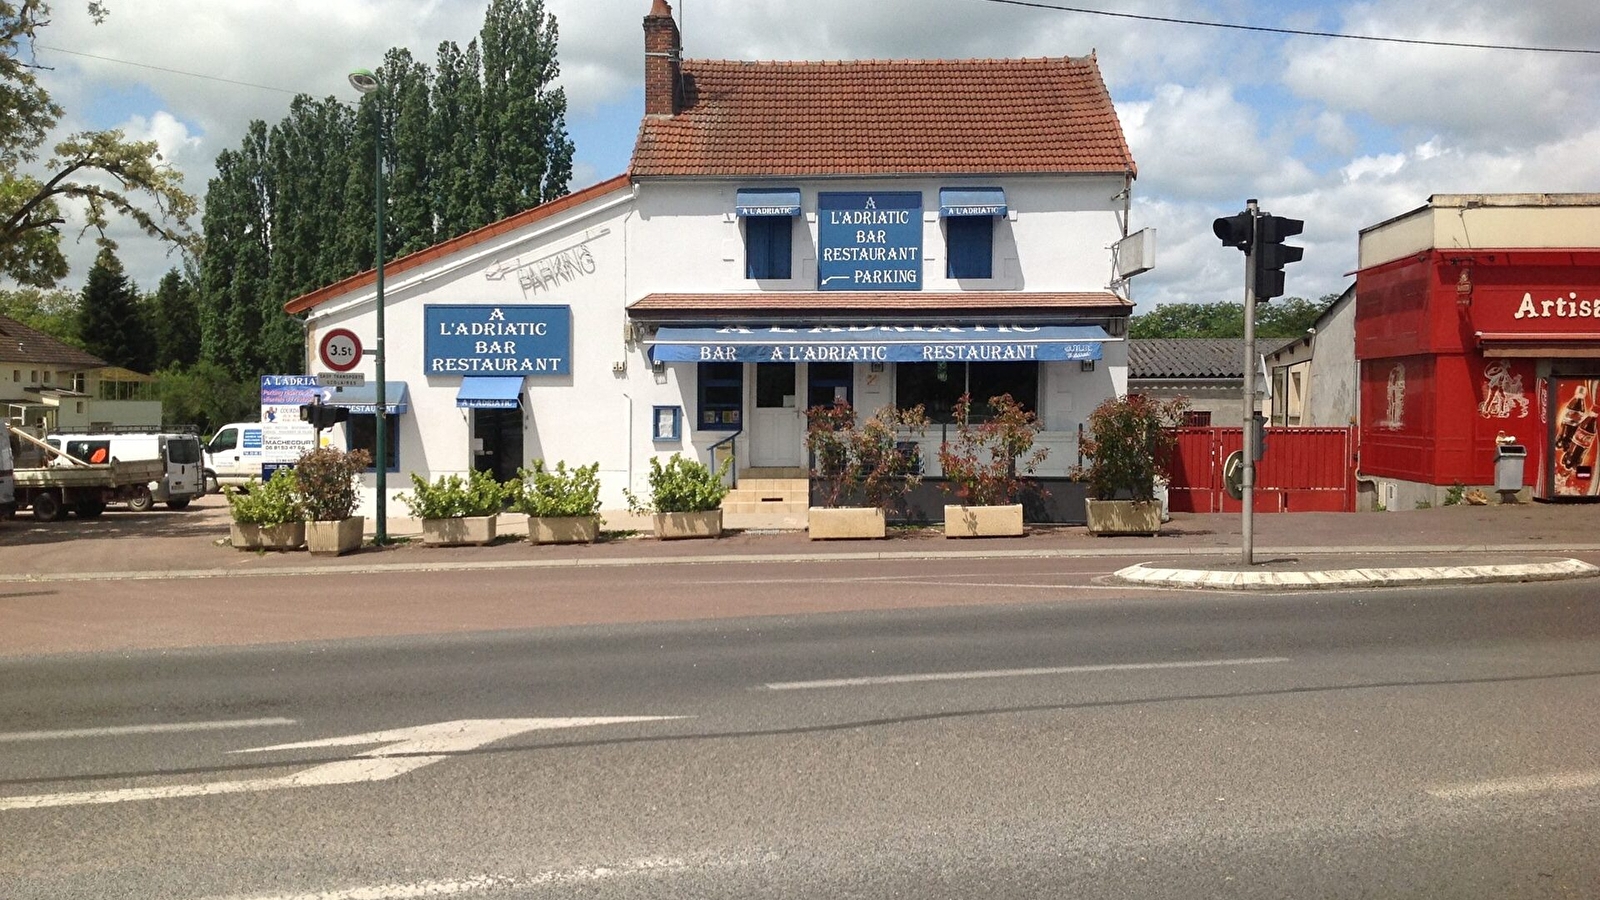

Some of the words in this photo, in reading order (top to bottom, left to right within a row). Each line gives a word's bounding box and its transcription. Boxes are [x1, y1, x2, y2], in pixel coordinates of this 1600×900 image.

[865, 196, 876, 209] A
[831, 211, 909, 225] L'ADRIATIC
[948, 207, 954, 215] A
[956, 207, 999, 215] L'ADRIATIC
[856, 230, 887, 244] BAR
[823, 247, 918, 262] RESTAURANT
[518, 244, 596, 300] PARKING
[854, 270, 917, 284] PARKING
[489, 308, 505, 320] A
[440, 322, 548, 336] L'ADRIATIC
[475, 341, 516, 354] BAR
[700, 346, 737, 361] BAR
[770, 346, 783, 360] A
[789, 346, 887, 360] L'ADRIATIC
[923, 345, 1038, 360] RESTAURANT
[432, 358, 561, 371] RESTAURANT
